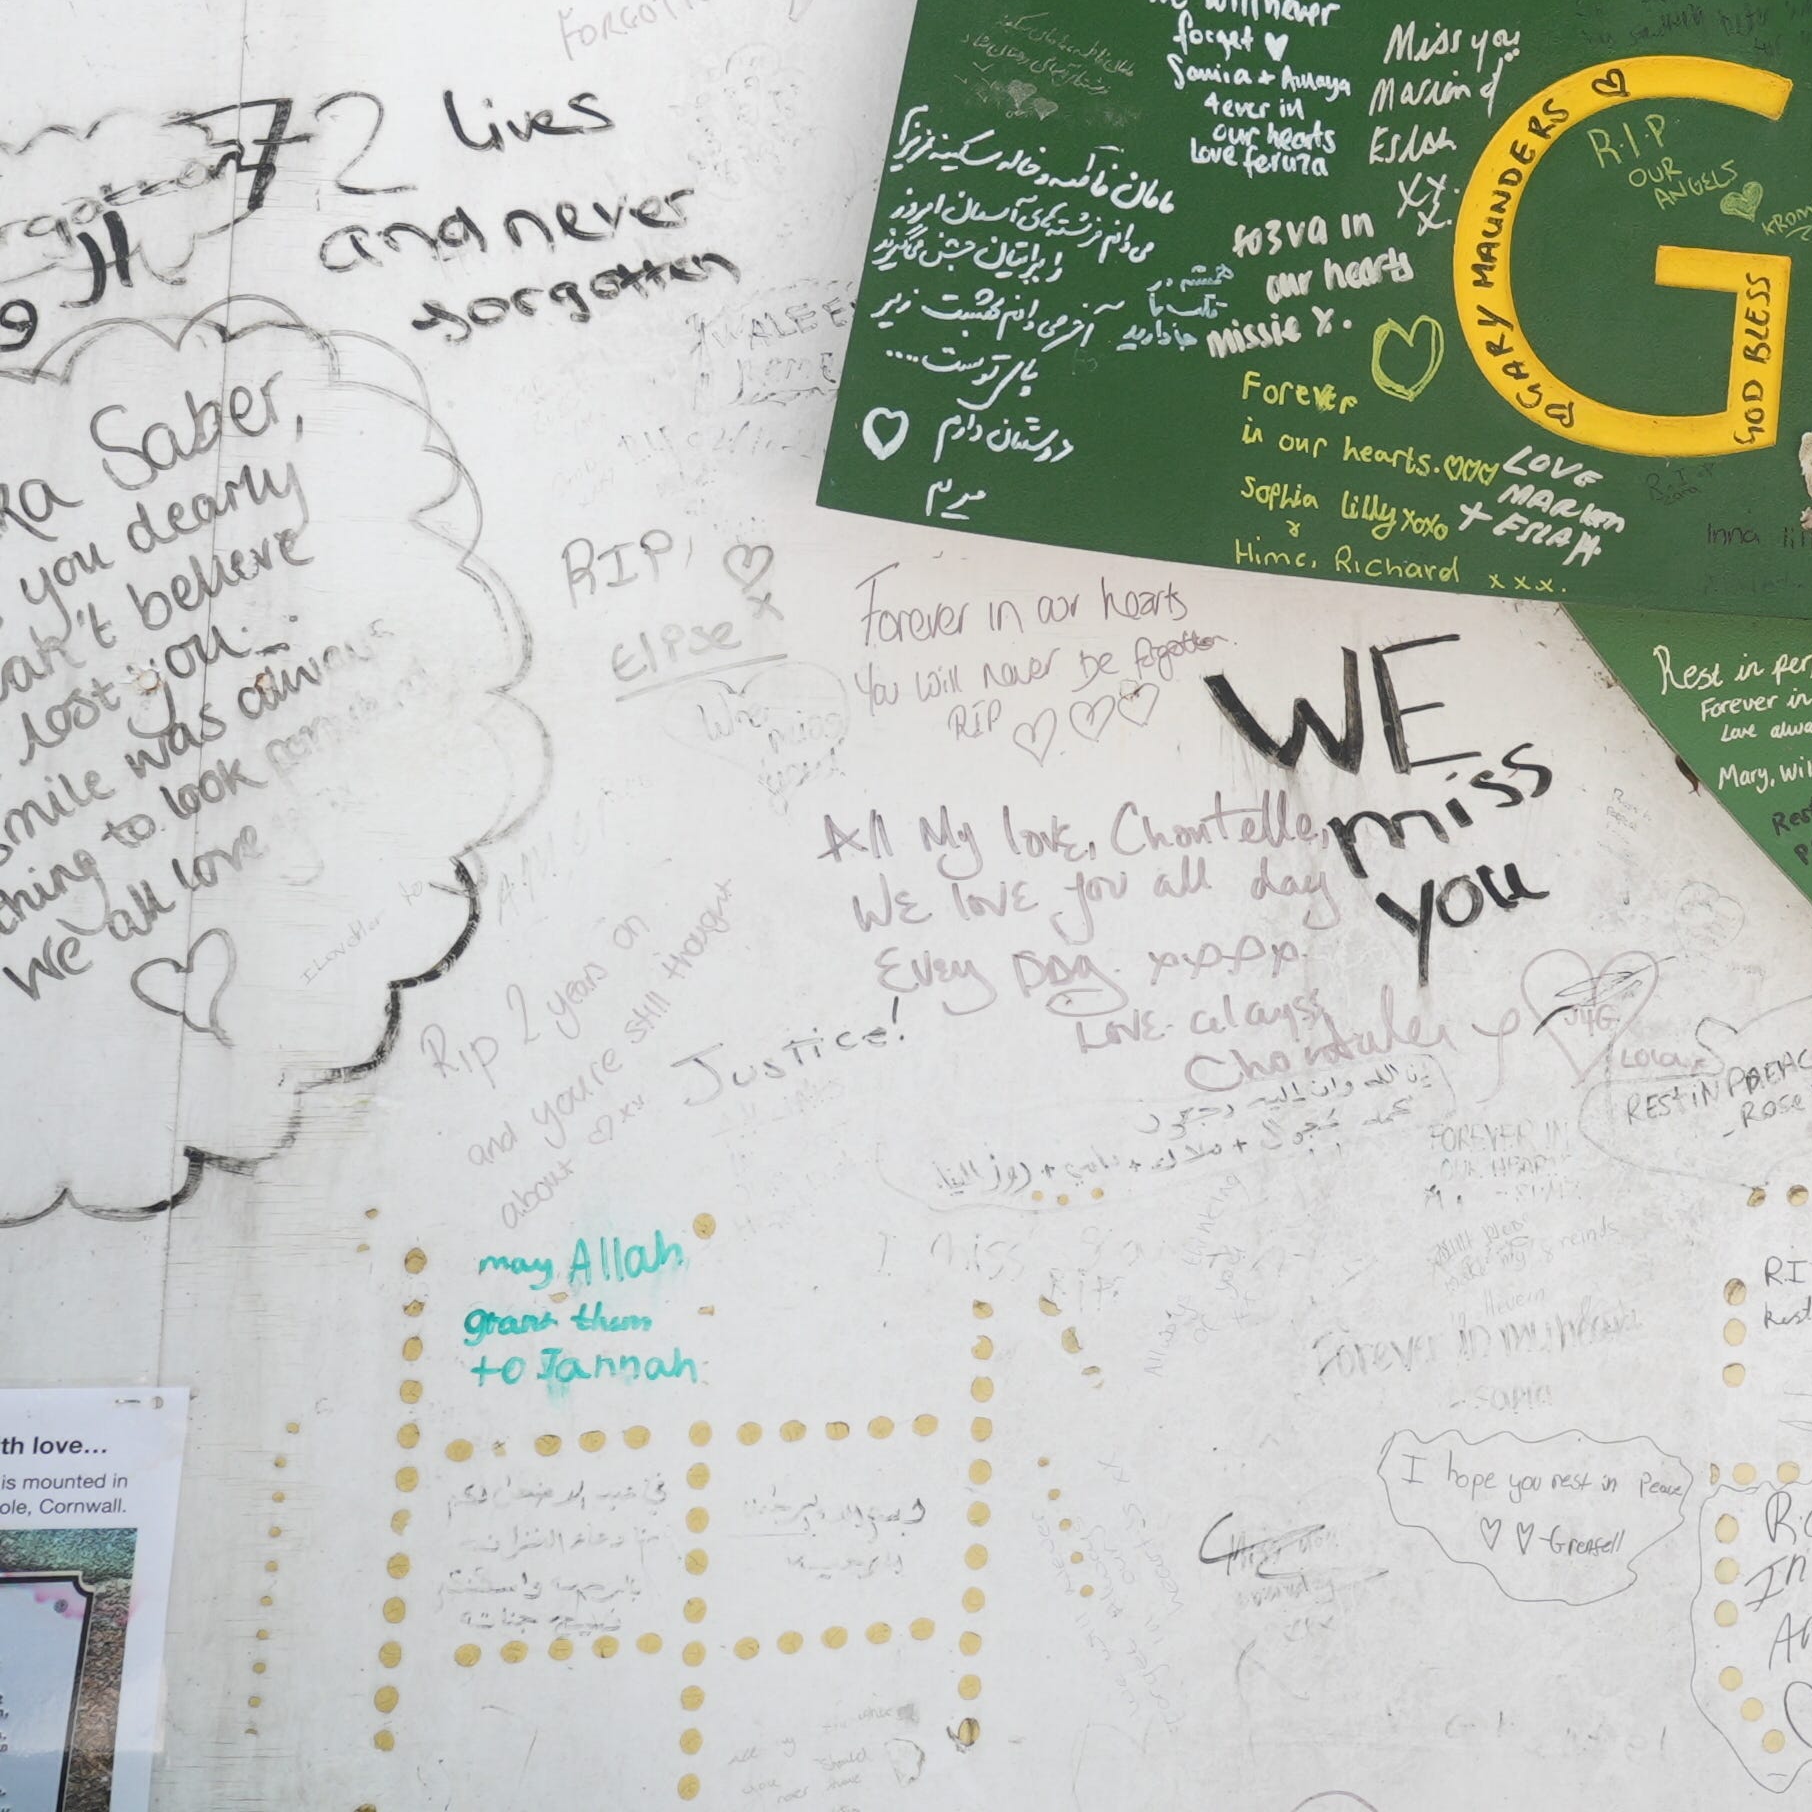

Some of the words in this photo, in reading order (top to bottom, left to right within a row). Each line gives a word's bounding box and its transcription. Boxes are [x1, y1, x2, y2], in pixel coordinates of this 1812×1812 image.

[1173, 10, 1253, 62] forget
[172, 90, 418, 212] 72
[1628, 157, 1682, 187] OUR
[1652, 160, 1739, 210] ANGELS
[318, 206, 488, 276] and
[502, 187, 696, 250] never
[1472, 97, 1570, 291] MAUNDERS
[1744, 272, 1773, 360] BLESS
[1475, 310, 1550, 411] GARY
[1732, 362, 1764, 446] GOD
[21, 542, 115, 646] you
[127, 462, 311, 555] dearly
[855, 561, 969, 646] Forever
[988, 598, 1024, 635] in
[1037, 594, 1082, 624] our
[1099, 575, 1189, 622] hearts
[1202, 632, 1483, 775] WE
[1652, 643, 1725, 694] Rest
[1736, 652, 1764, 683] in
[1324, 739, 1555, 878] miss
[1374, 861, 1553, 988] you
[478, 1249, 555, 1290] may
[566, 1228, 687, 1286] Allah
[463, 1305, 558, 1345] grant
[470, 1354, 524, 1388] to
[536, 1346, 698, 1386] Jannah
[23, 1474, 106, 1490] mounted
[113, 1474, 129, 1489] in
[39, 1497, 127, 1514] Cornwall.
